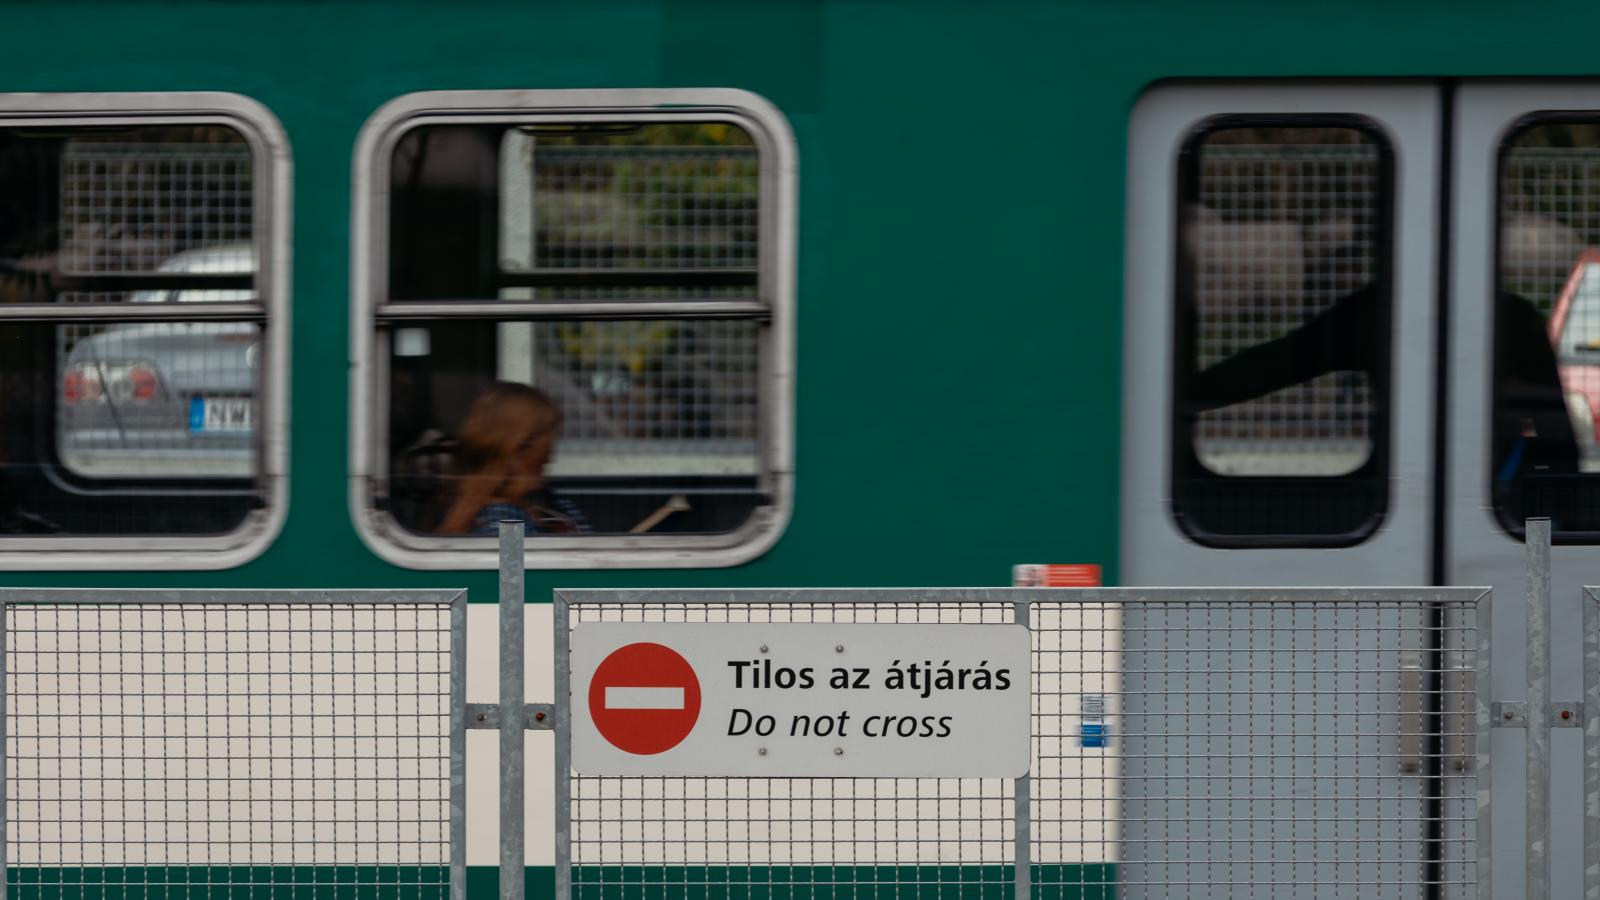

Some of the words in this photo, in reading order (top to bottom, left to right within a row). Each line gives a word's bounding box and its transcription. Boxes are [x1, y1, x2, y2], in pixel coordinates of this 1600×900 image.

[728, 659, 814, 690] Tilos
[829, 667, 870, 690] az
[884, 659, 1010, 699] átjárás
[727, 708, 776, 737] Do
[789, 710, 850, 737] not
[863, 715, 953, 738] cross
